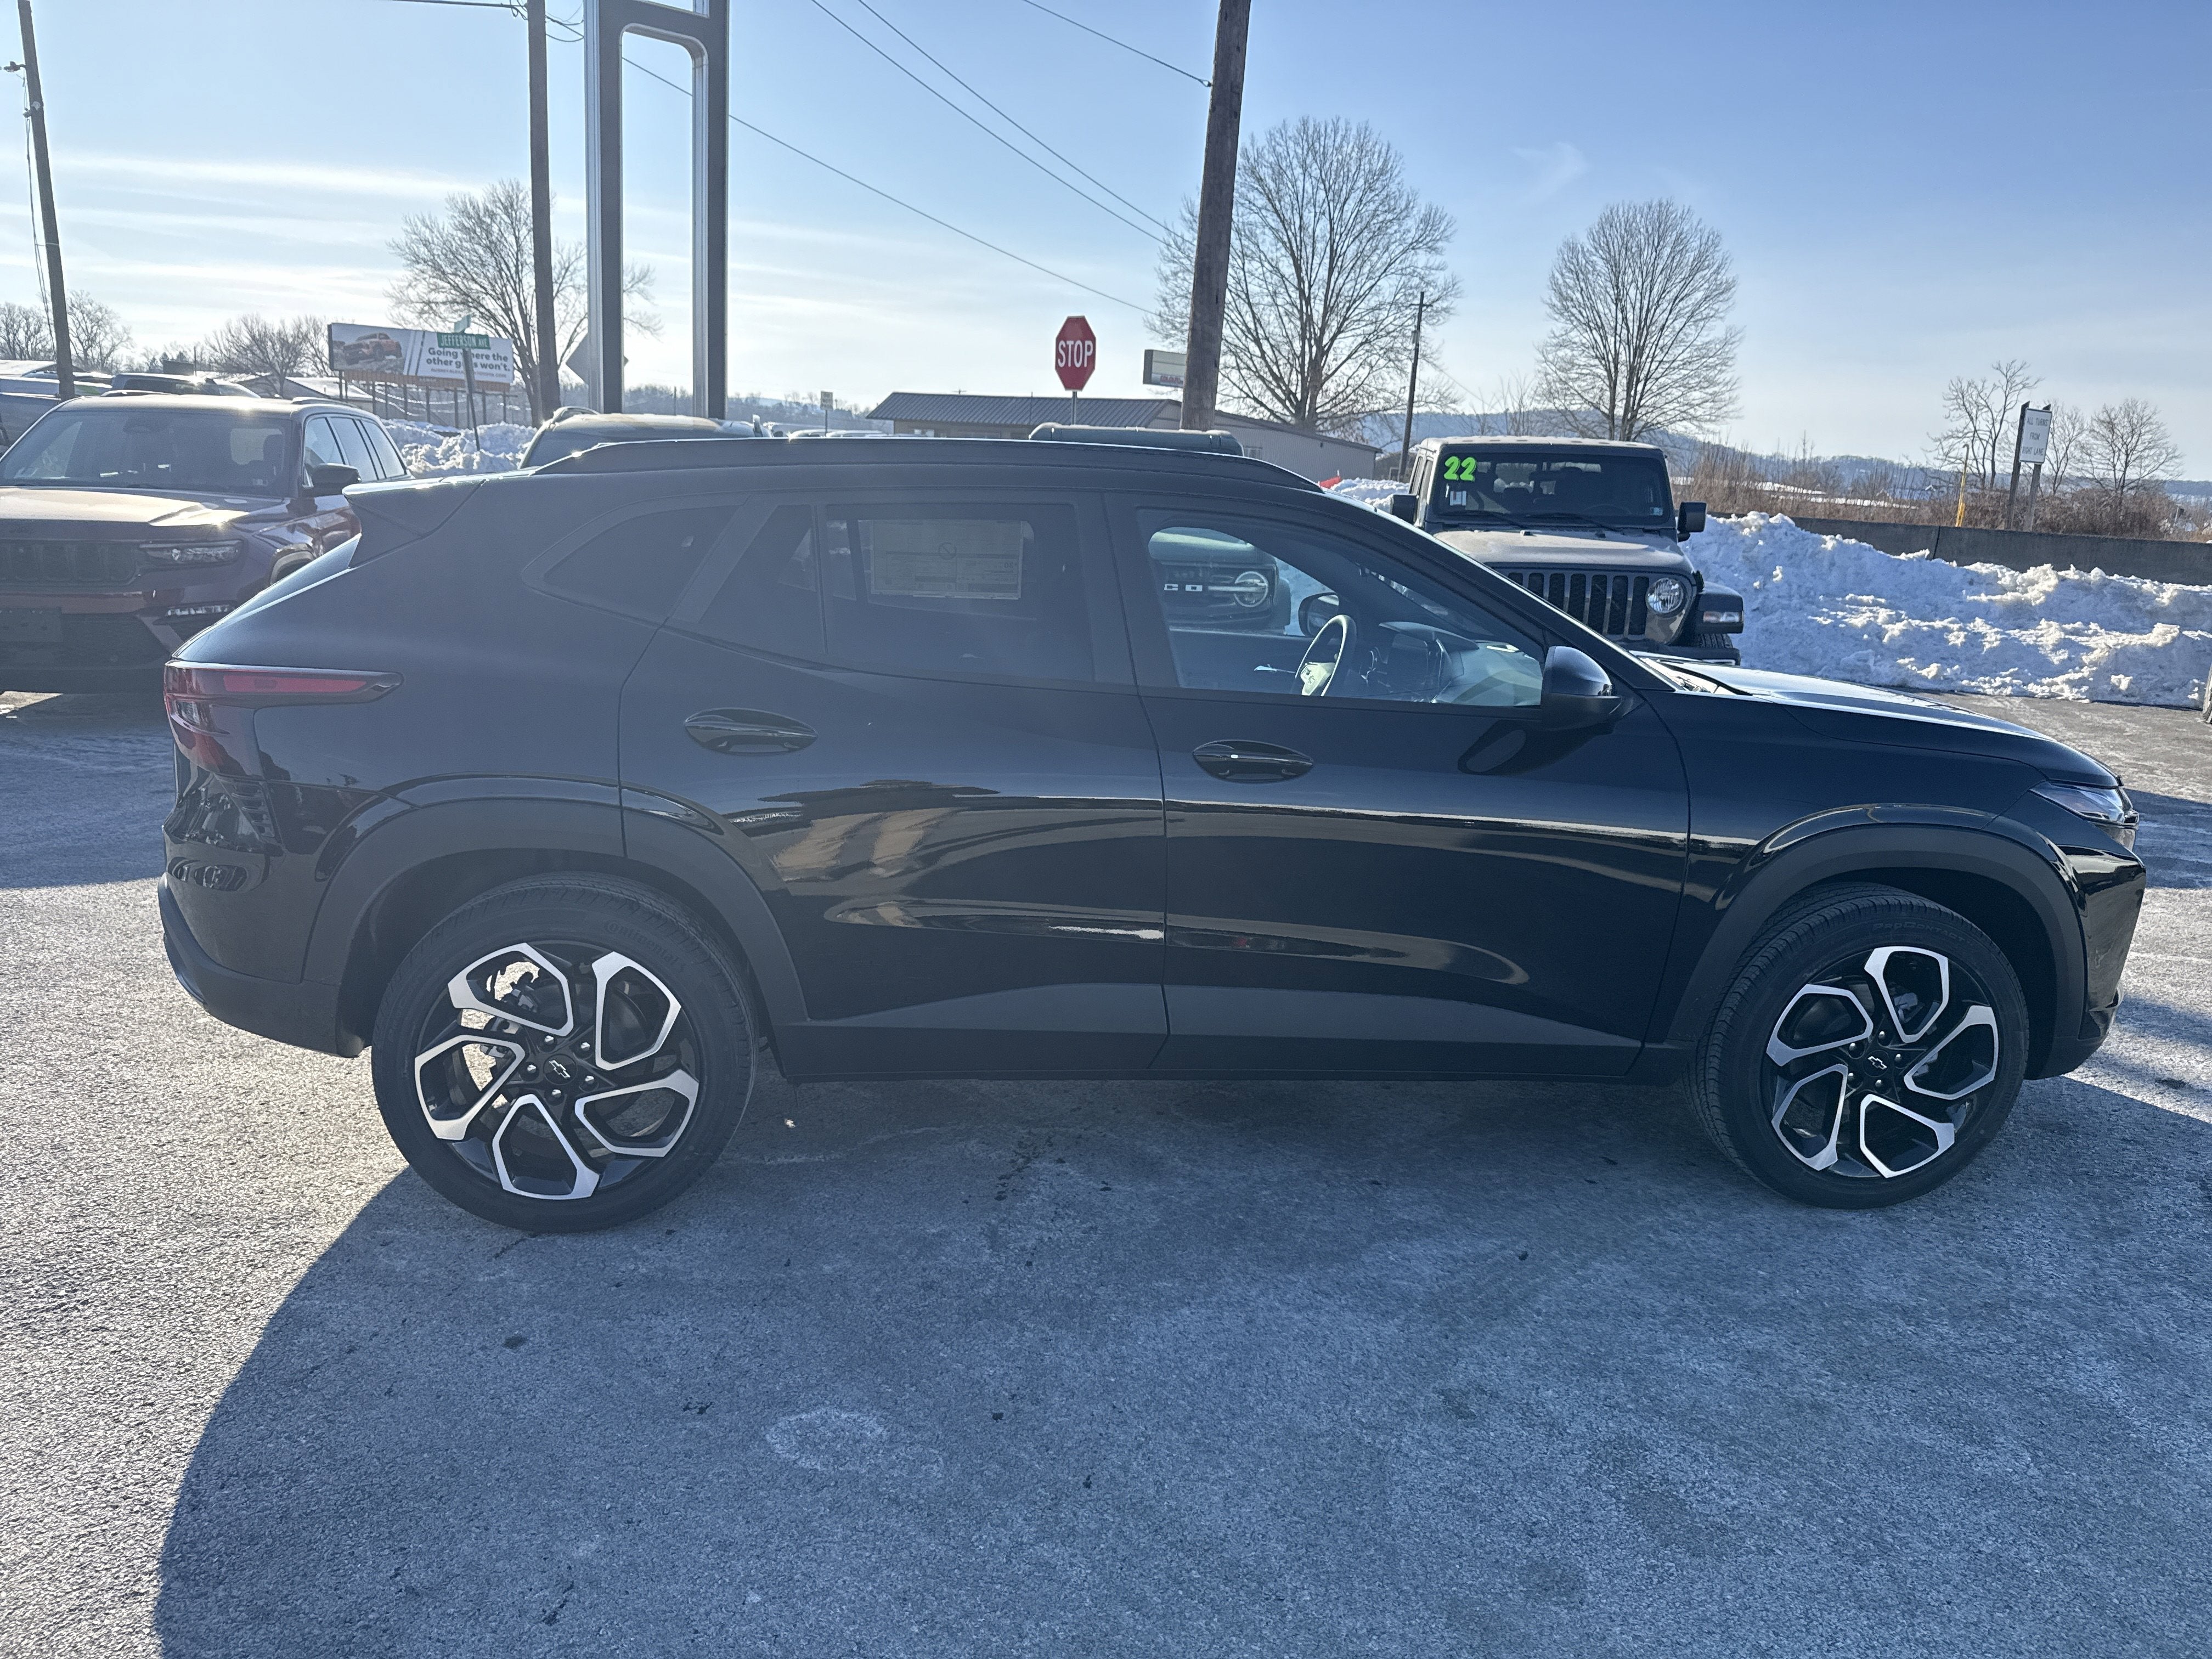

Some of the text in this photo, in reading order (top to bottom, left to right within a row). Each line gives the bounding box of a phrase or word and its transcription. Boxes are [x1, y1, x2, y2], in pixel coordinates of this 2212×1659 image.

[441, 334, 488, 347] JEFFERSON AVE
[428, 348, 458, 359] Going
[492, 353, 509, 362] the
[1058, 340, 1093, 368] STOP
[426, 357, 453, 366] other
[480, 363, 510, 371] won't.
[2036, 418, 2048, 426] TURNS
[2034, 447, 2044, 455] LANE
[1444, 456, 1477, 481] 22
